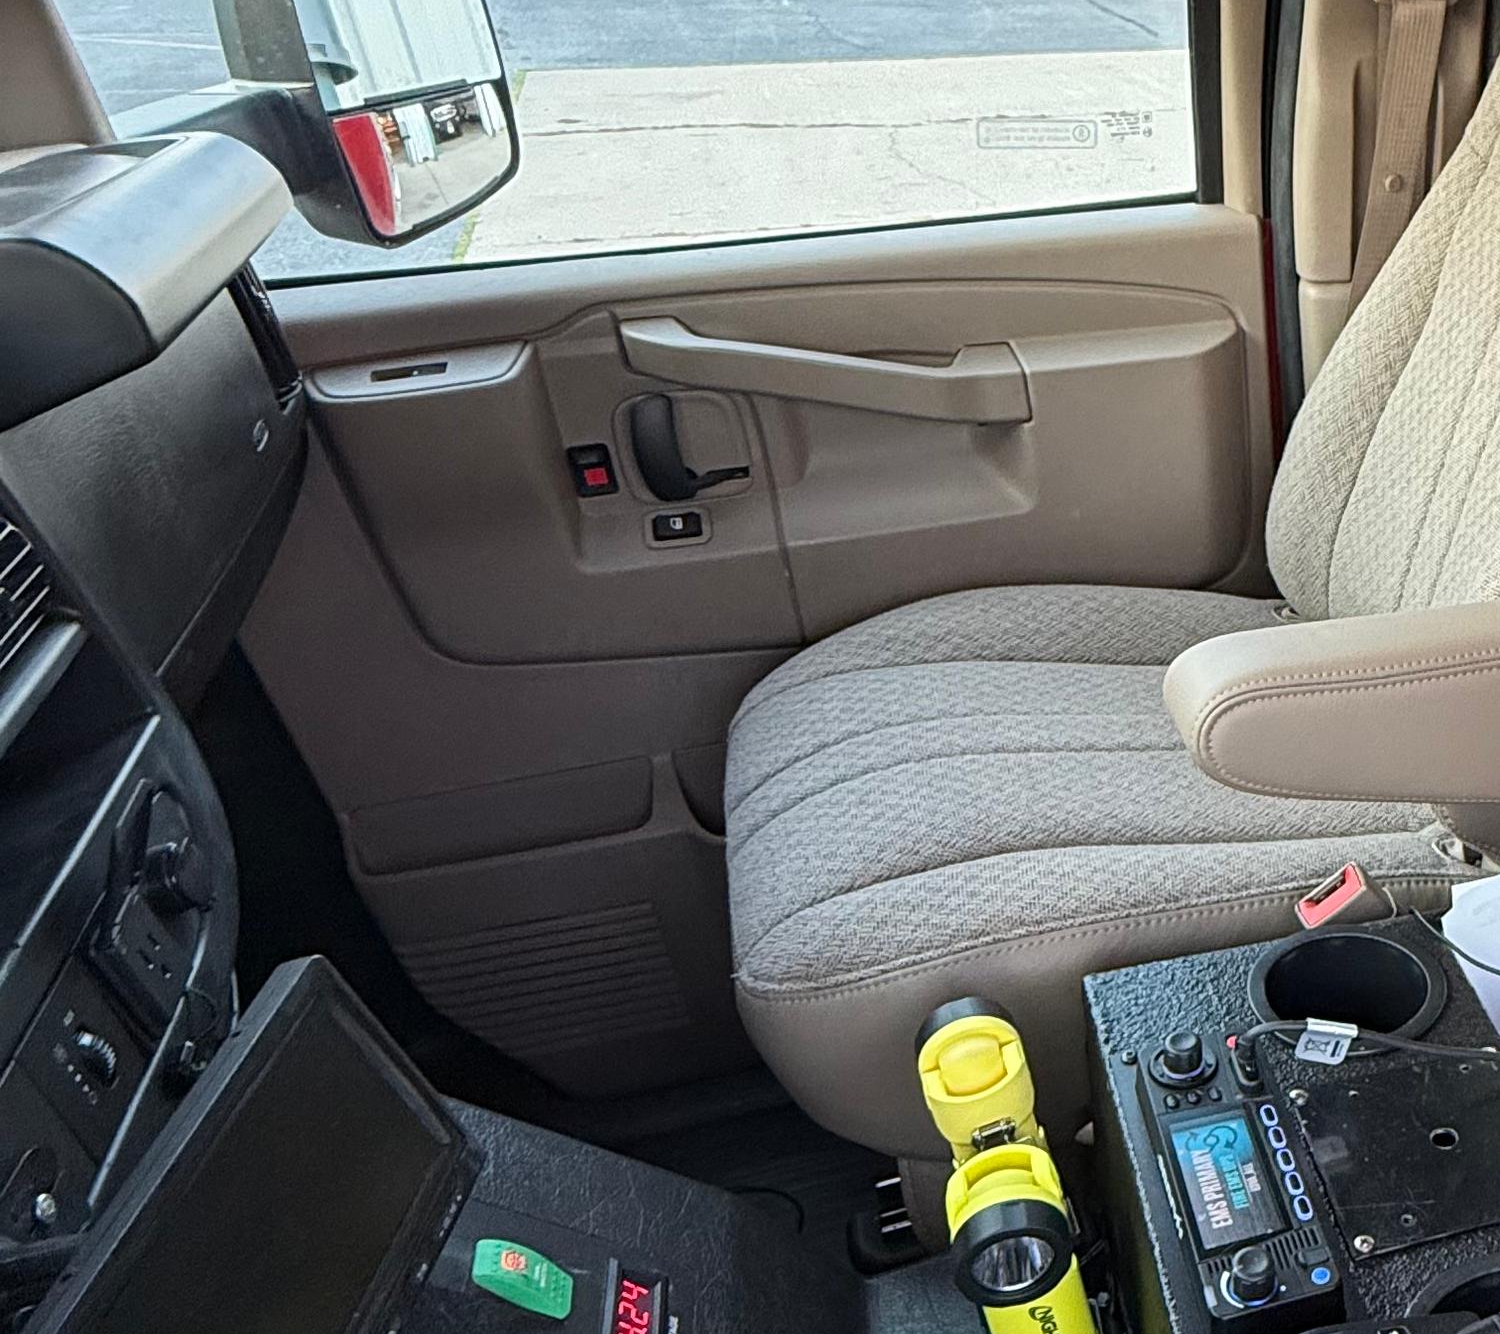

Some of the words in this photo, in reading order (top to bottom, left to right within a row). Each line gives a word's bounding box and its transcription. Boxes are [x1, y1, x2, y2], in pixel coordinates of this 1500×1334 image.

[1190, 1149, 1224, 1202] PRIMARY
[1225, 1170, 1243, 1190] EMS
[1230, 1188, 1250, 1209] FIRE
[1206, 1200, 1233, 1230] EMS
